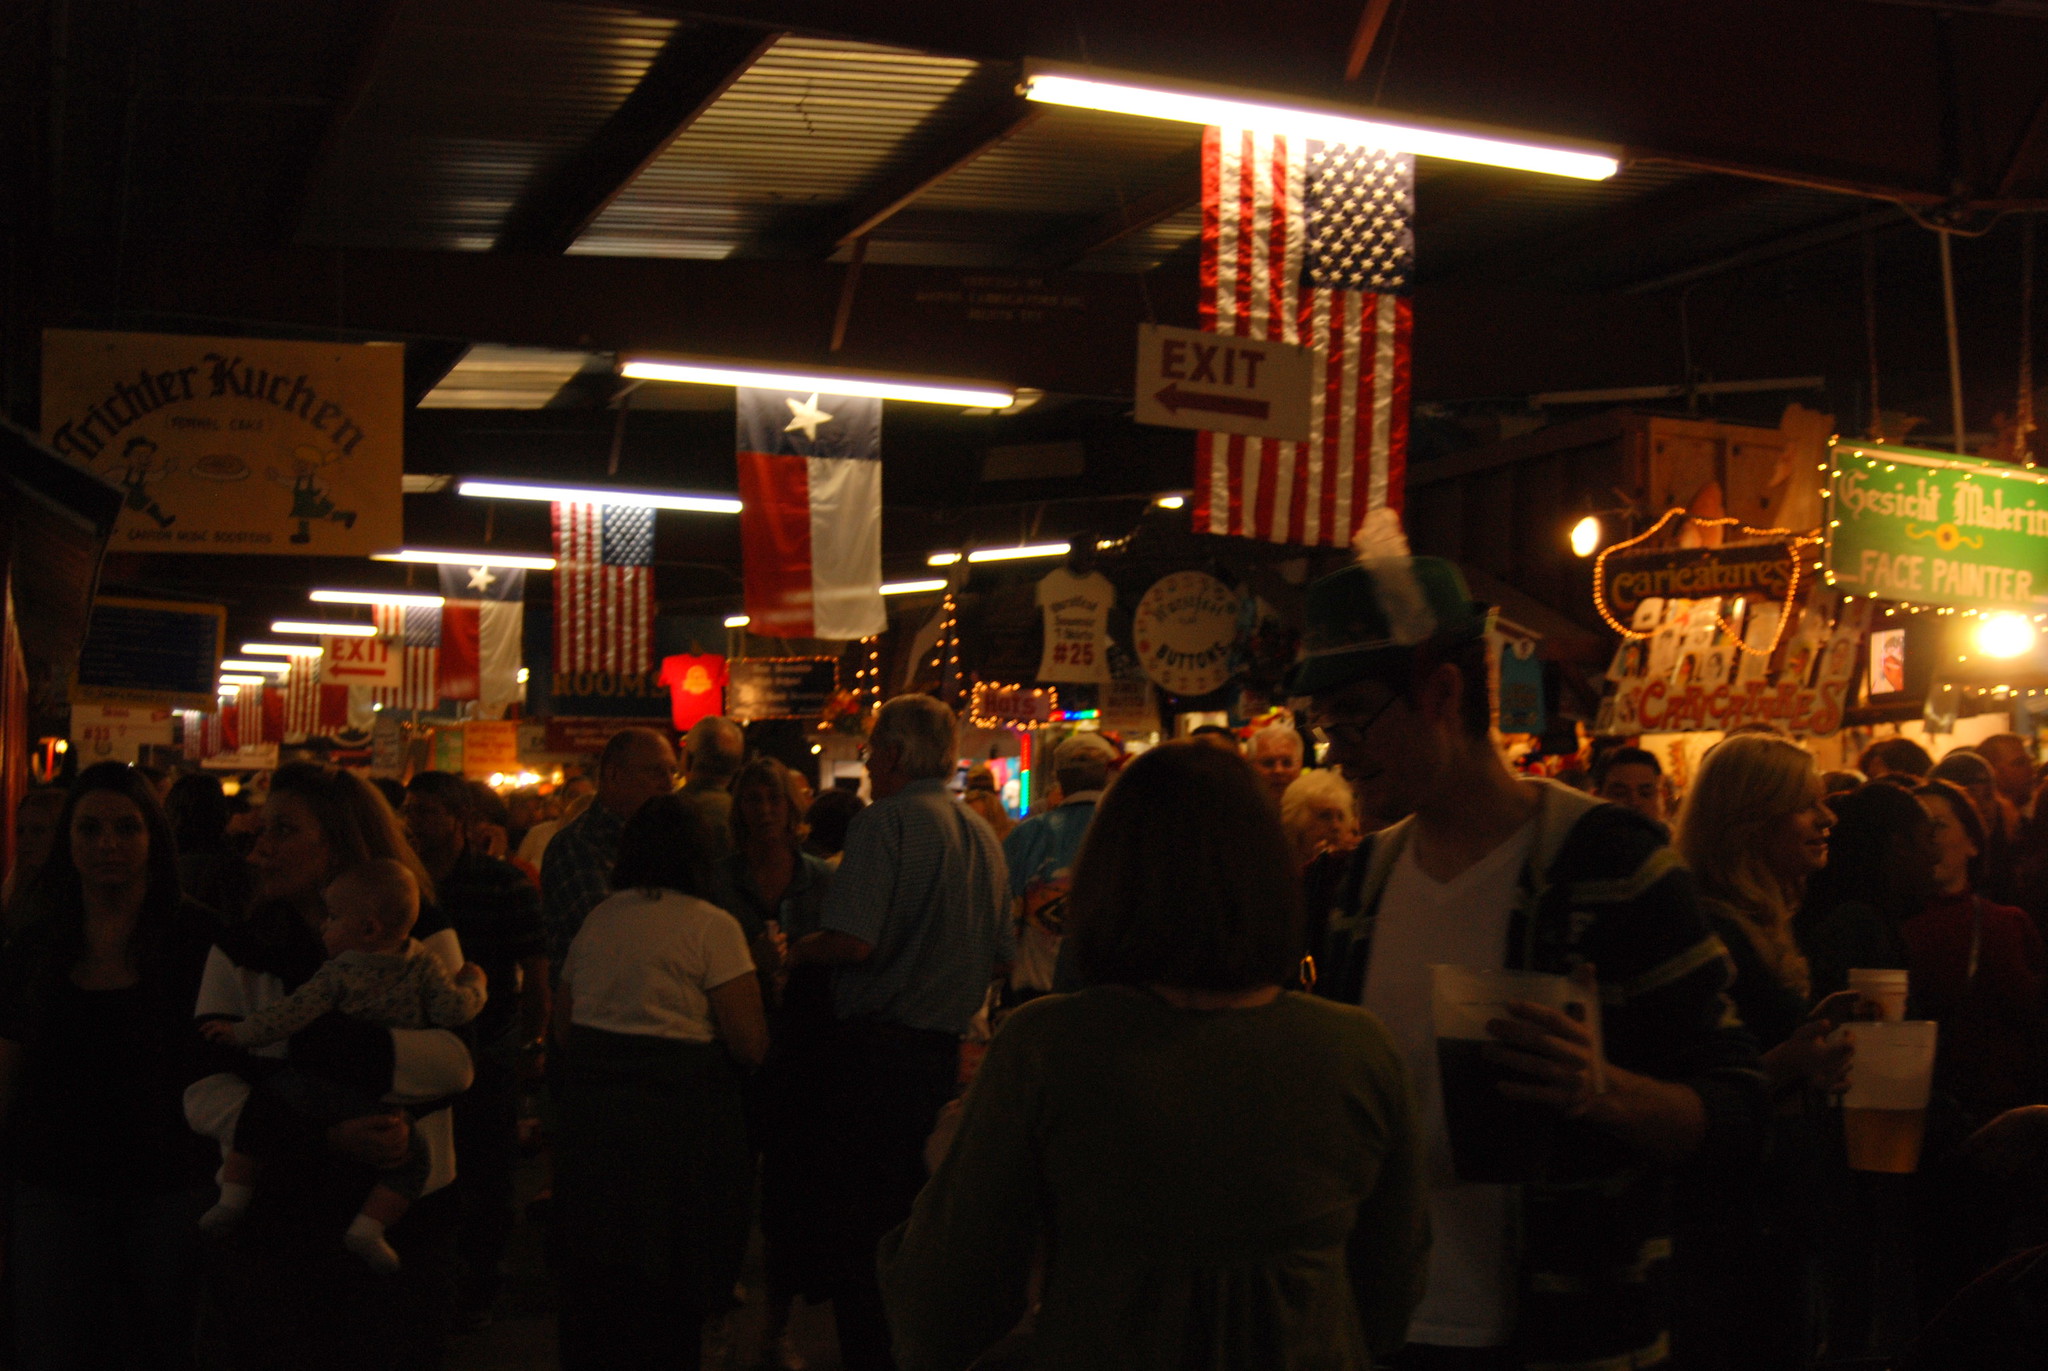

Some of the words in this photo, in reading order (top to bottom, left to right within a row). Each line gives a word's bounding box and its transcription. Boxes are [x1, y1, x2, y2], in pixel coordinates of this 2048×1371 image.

[1161, 339, 1266, 388] EXIT
[53, 366, 198, 460] Trichter
[204, 352, 365, 454] Kuchen
[1838, 468, 1941, 522] Gesicht
[1858, 549, 1925, 591] FACE
[1932, 557, 2034, 601] PAINTER
[331, 638, 392, 662] EXIT
[1053, 642, 1094, 666] #25
[1156, 642, 1227, 670] BUTTONS
[552, 672, 669, 698] ROOMS
